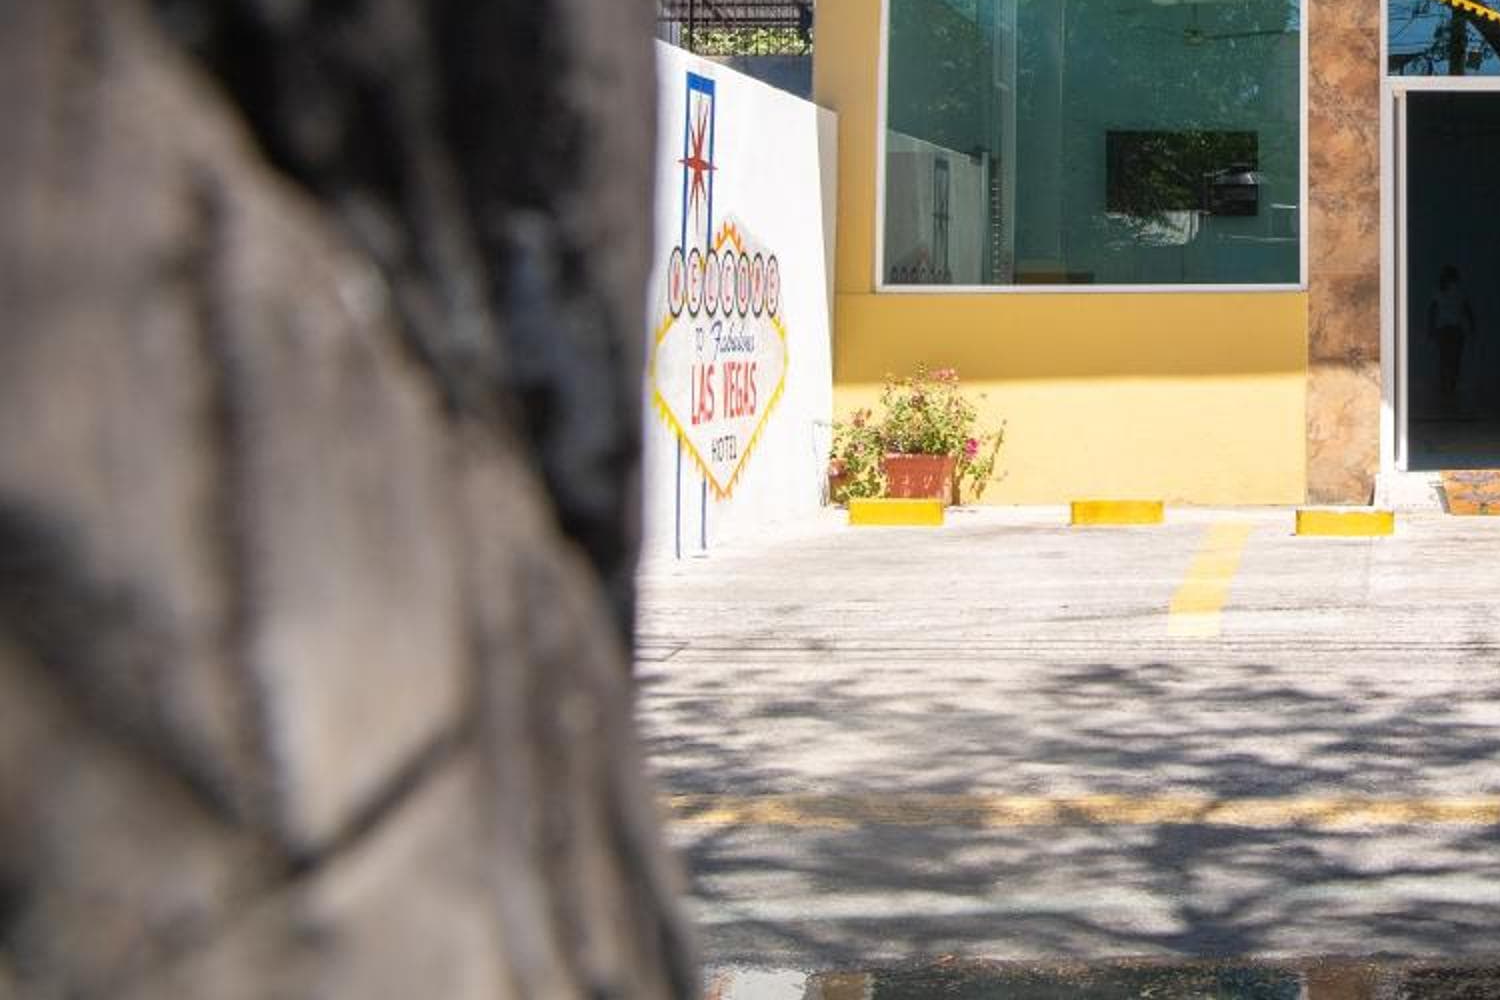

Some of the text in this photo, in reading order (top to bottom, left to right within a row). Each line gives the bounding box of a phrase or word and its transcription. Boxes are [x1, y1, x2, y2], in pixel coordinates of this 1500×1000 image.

[670, 255, 778, 307] WELCOME
[691, 361, 757, 425] LAS VEGAS
[711, 434, 737, 464] HOTEL
